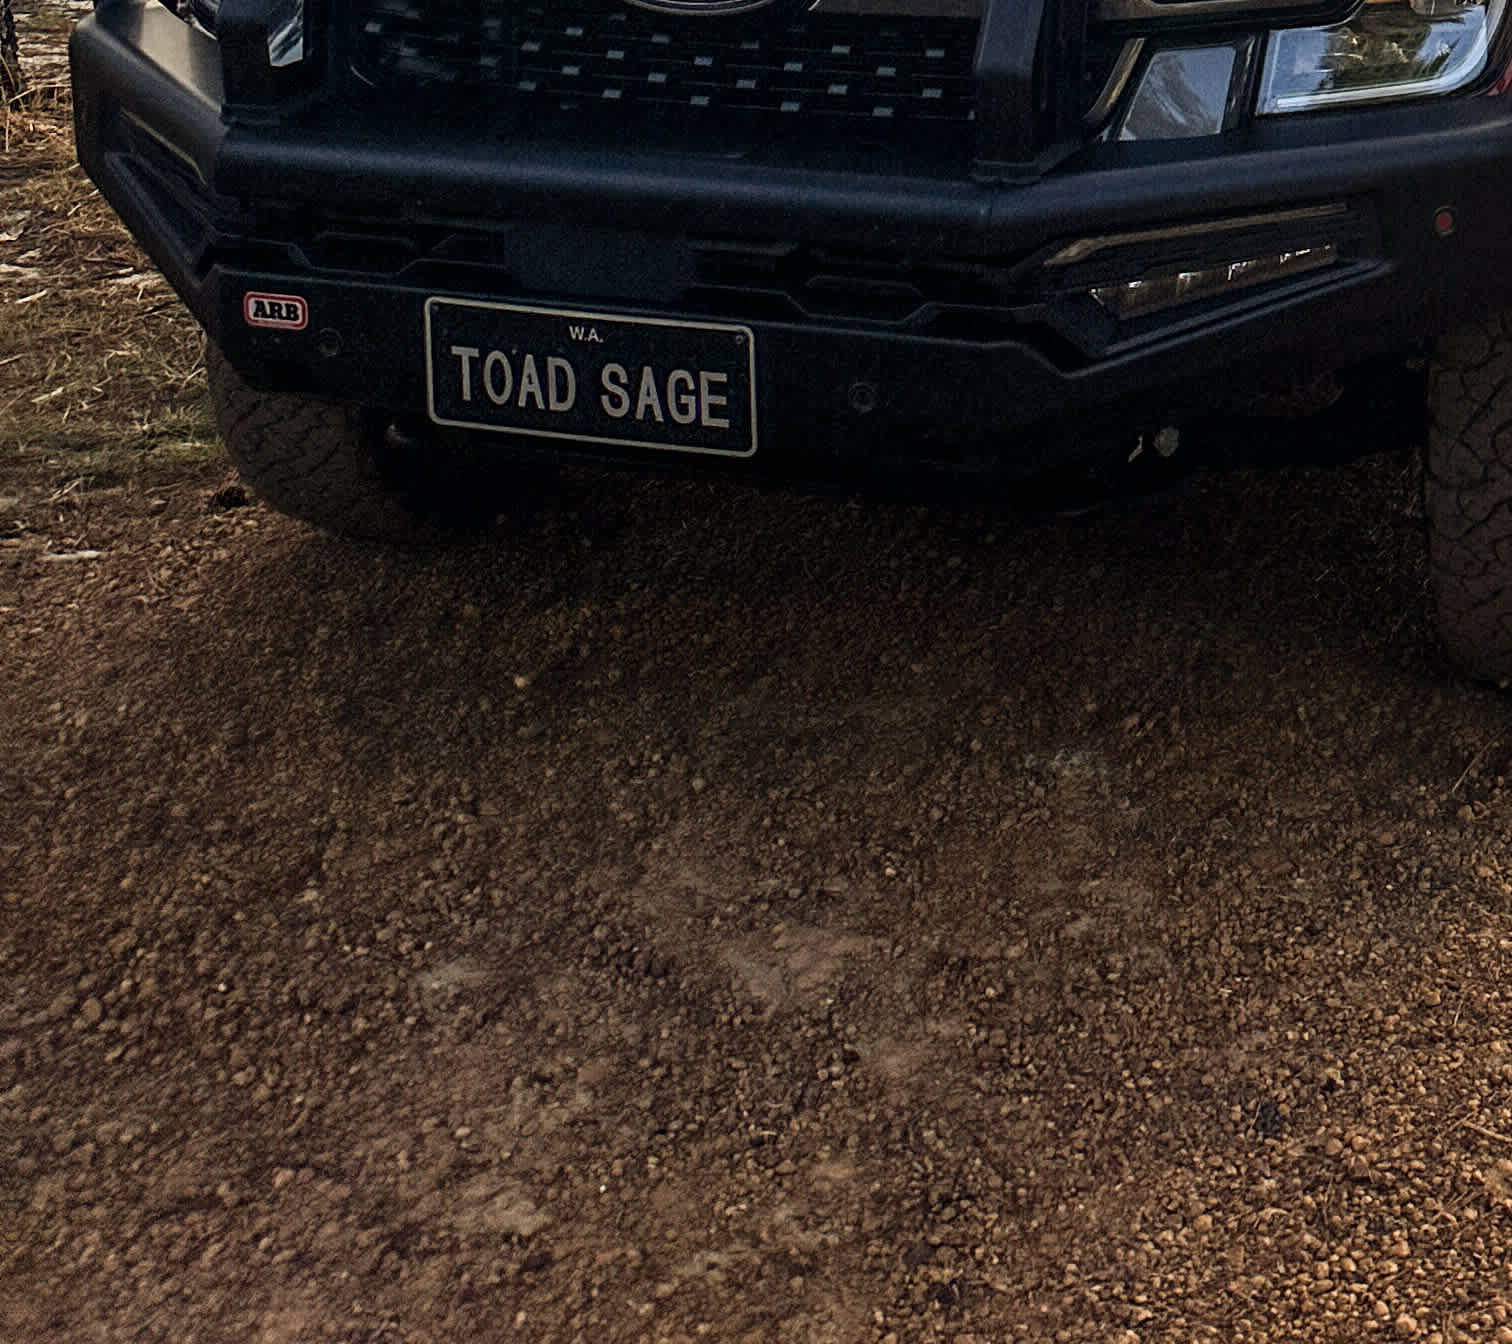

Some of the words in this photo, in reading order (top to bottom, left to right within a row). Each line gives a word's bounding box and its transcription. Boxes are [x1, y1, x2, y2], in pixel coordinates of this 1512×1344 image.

[253, 299, 300, 321] ARB
[568, 325, 604, 343] W.A.
[451, 345, 577, 412] TOAD
[600, 362, 731, 429] SAGE
